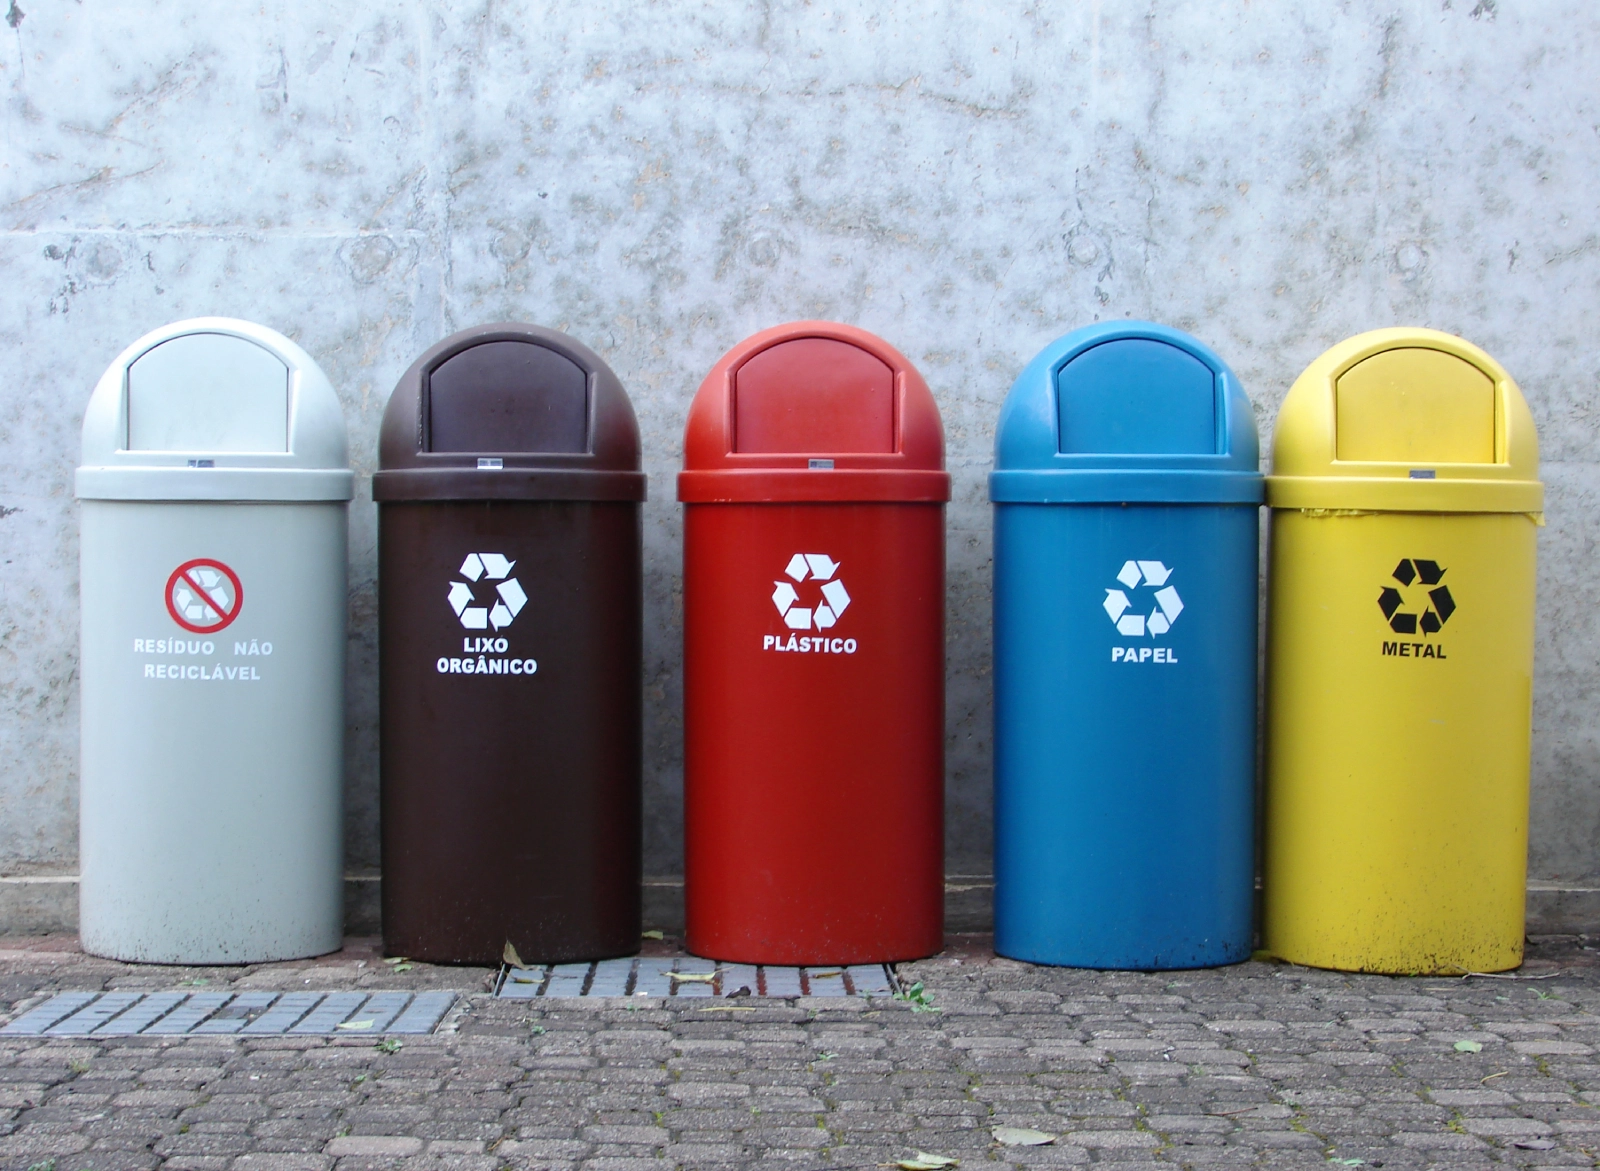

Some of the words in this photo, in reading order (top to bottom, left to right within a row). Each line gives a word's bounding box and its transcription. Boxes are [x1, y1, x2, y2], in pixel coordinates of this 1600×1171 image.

[134, 638, 215, 655] RESÍDUO
[234, 639, 273, 656] NÃO
[463, 638, 509, 653] LIXO
[763, 633, 857, 654] PLÁSTICO
[1382, 641, 1447, 659] METAL
[1111, 647, 1178, 664] PAPEL
[144, 662, 261, 681] RECICLÁVEL
[436, 655, 538, 675] ORGÂNICO
